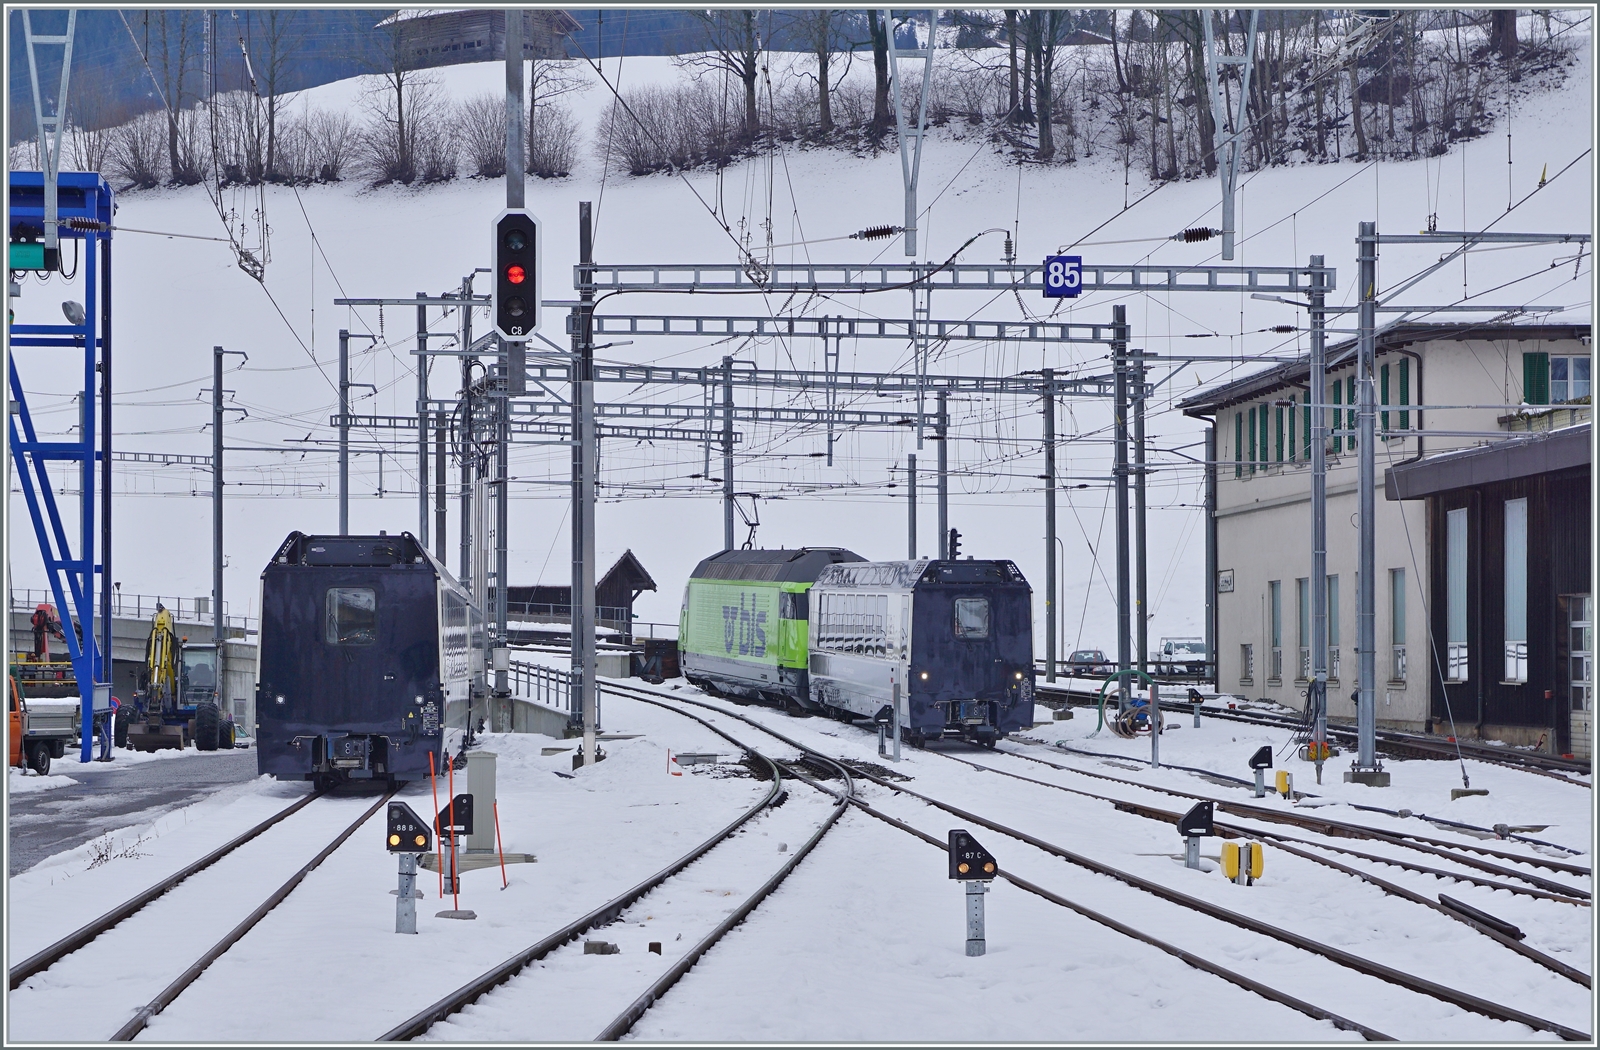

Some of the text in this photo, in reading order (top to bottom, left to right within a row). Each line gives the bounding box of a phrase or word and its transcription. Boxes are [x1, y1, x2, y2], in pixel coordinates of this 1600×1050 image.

[1048, 262, 1080, 288] 85
[511, 326, 522, 335] C8
[965, 851, 982, 859] 87 C
